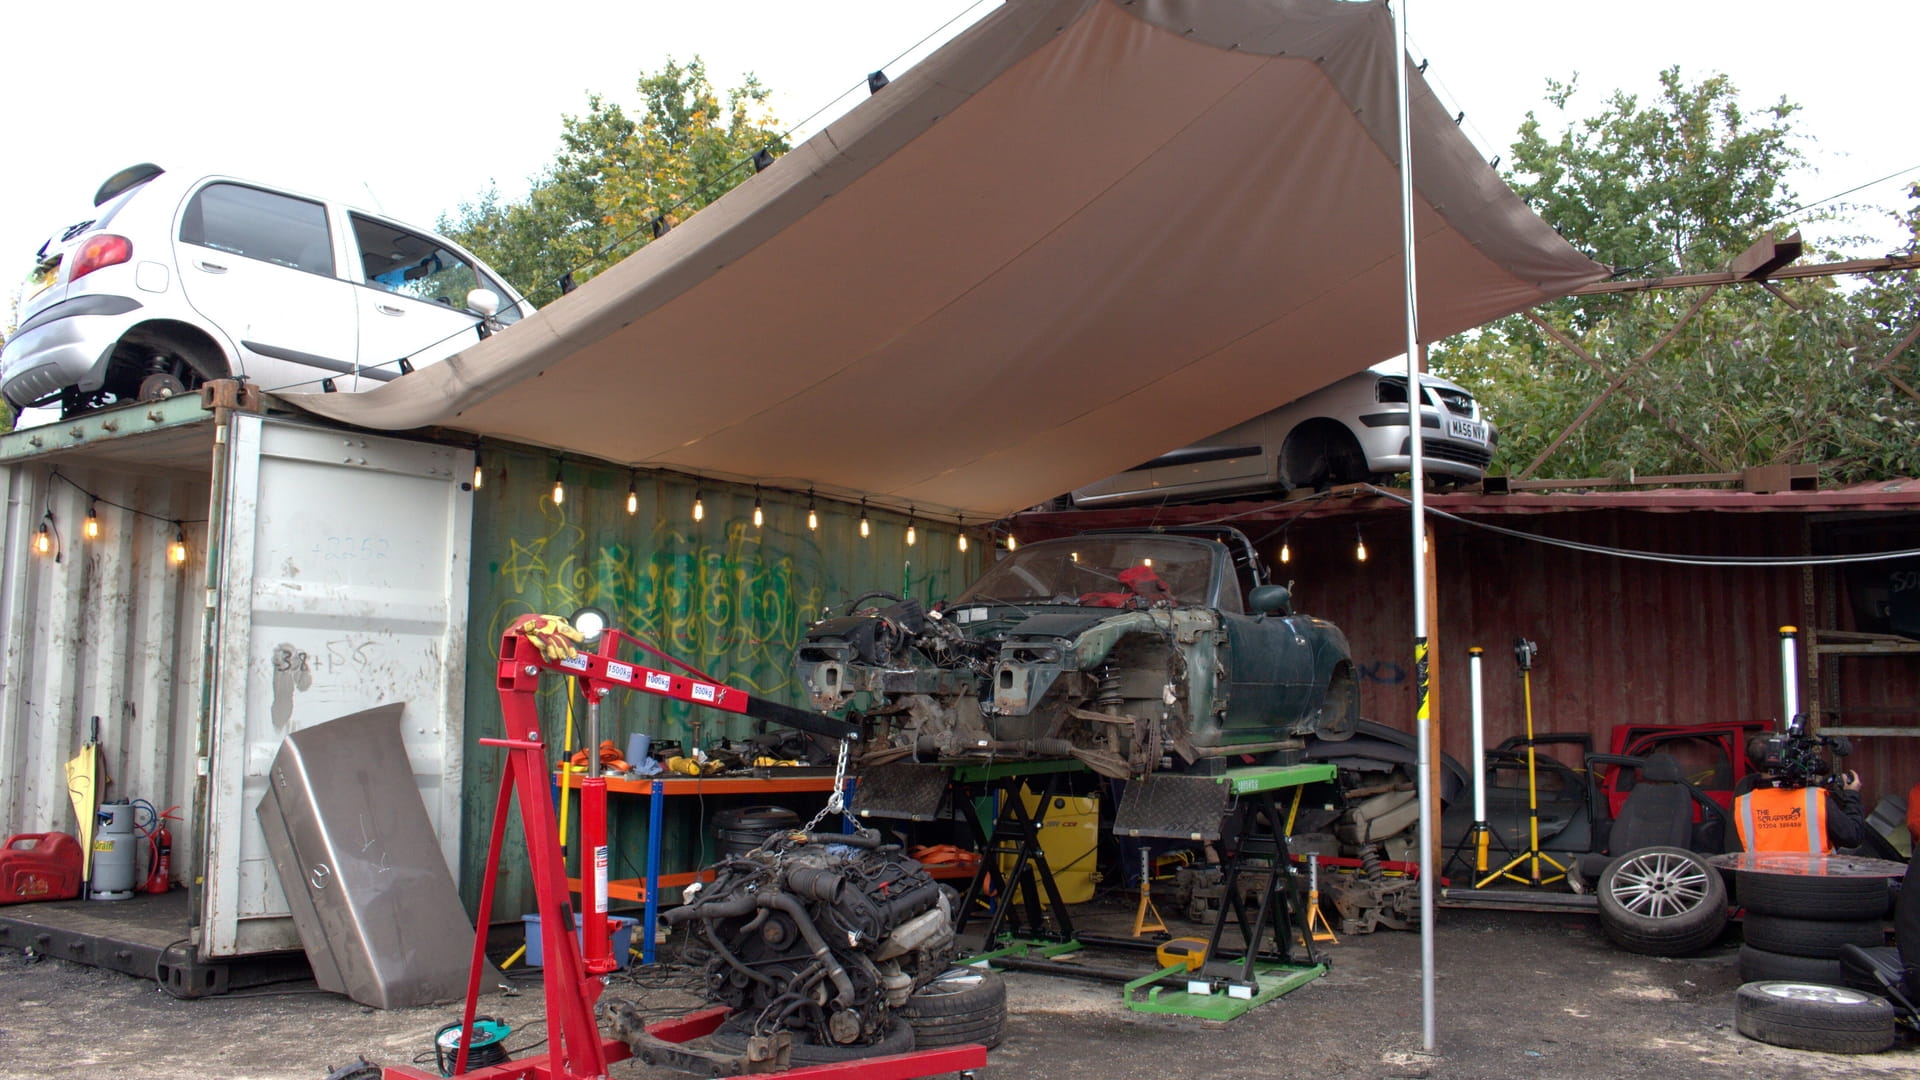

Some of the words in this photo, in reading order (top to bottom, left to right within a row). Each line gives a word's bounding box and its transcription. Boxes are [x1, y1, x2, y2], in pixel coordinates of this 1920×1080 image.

[1452, 420, 1472, 438] MA56
[608, 664, 632, 680] 1500kg
[694, 686, 713, 699] 500kg
